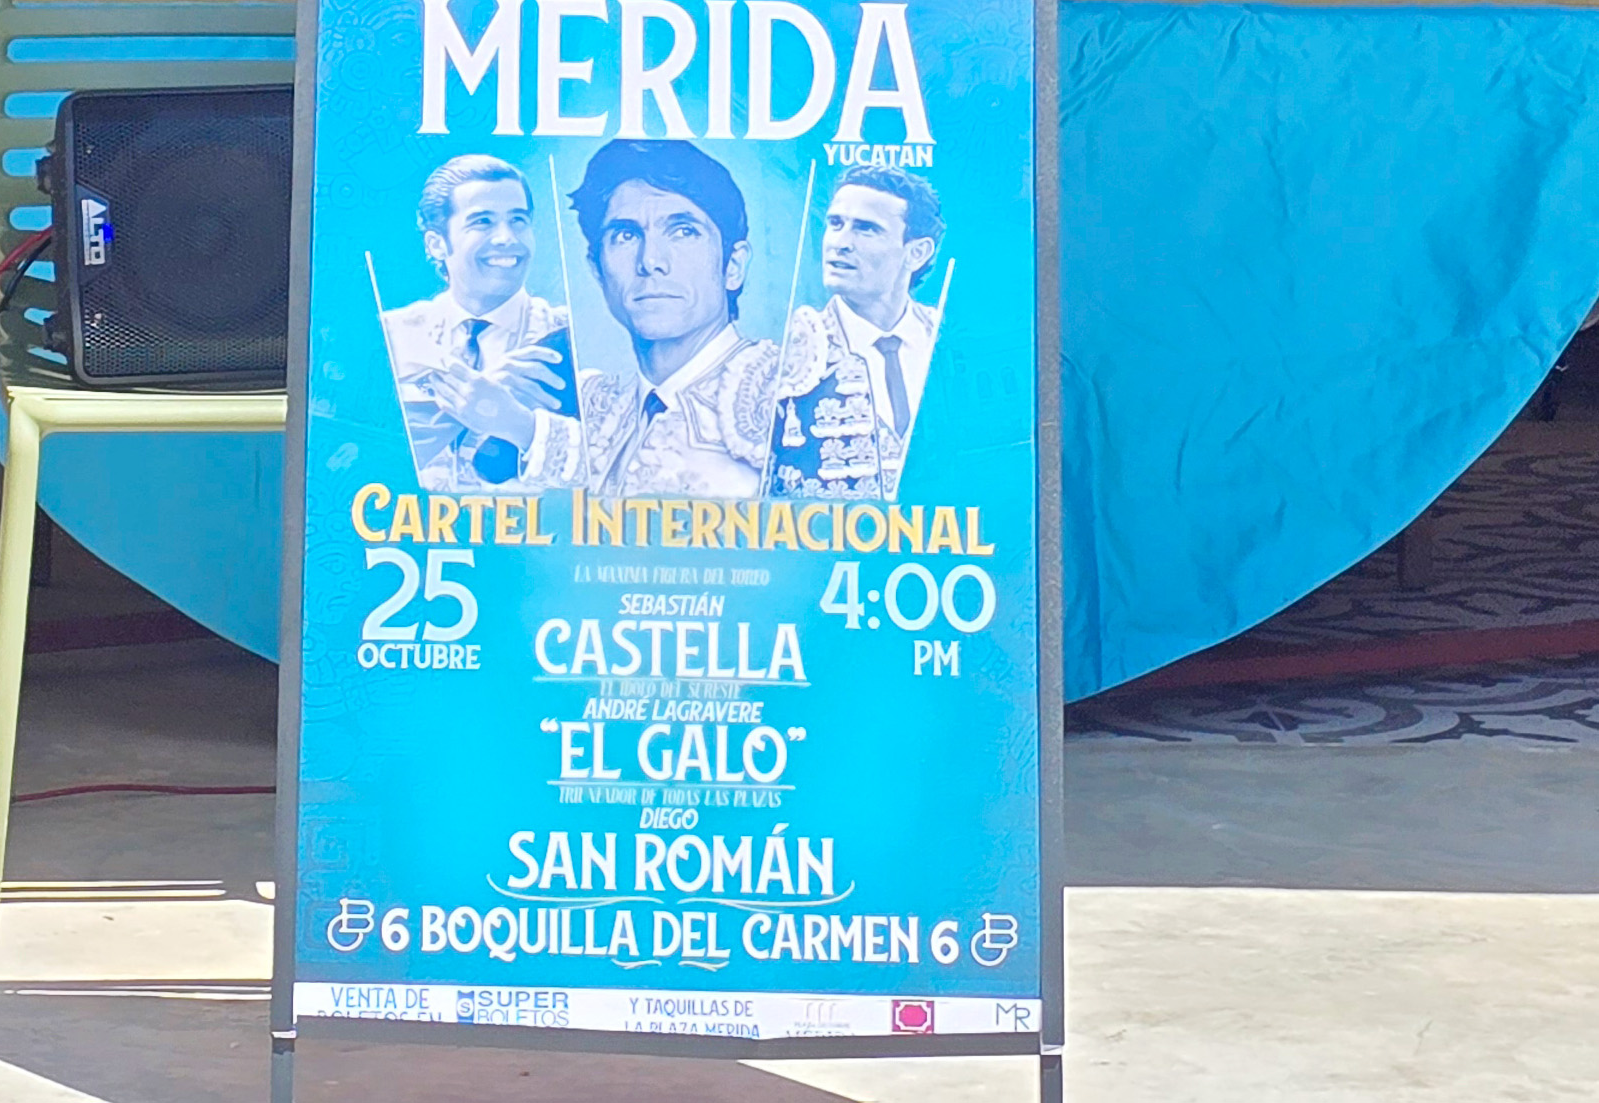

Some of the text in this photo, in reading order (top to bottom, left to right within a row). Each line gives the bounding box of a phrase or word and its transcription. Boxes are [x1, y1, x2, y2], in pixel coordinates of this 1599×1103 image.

[822, 143, 934, 168] YUCATAN
[87, 198, 107, 265] ALTO
[351, 484, 996, 556] CARTEL INTERNACIONAL
[361, 547, 479, 641] 25
[617, 591, 726, 618] SEBASTIÁN
[819, 561, 997, 633] 4:00
[357, 642, 481, 670] OCTUBRE
[532, 616, 807, 680] CASTELLA
[913, 640, 960, 677] PM
[581, 696, 765, 724] ANDRÉ LAGRAVERE
[538, 716, 808, 785] “EL GALO”
[639, 807, 700, 830] DIEGO
[507, 822, 835, 896] SAN ROMÁN
[379, 905, 962, 966] 6 BOQUILLA DEL CARMEN 6
[330, 986, 431, 1010] VENTA DE
[477, 989, 570, 1009] SUPER
[628, 997, 754, 1018] Y TAQUILLAS DE
